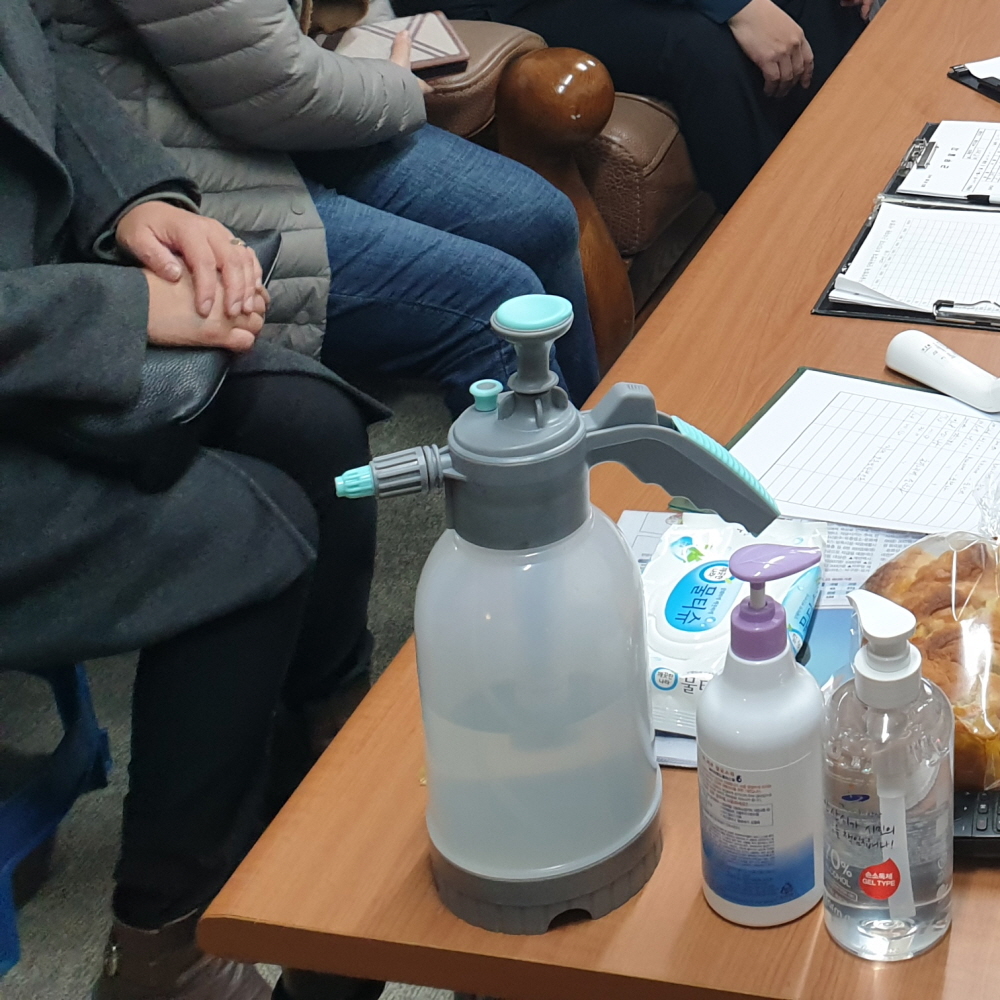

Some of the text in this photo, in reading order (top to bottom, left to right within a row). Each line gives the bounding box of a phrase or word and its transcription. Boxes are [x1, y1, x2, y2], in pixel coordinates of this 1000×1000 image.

[675, 584, 717, 624] 물티슈
[862, 878, 896, 887] GEL TYPE
